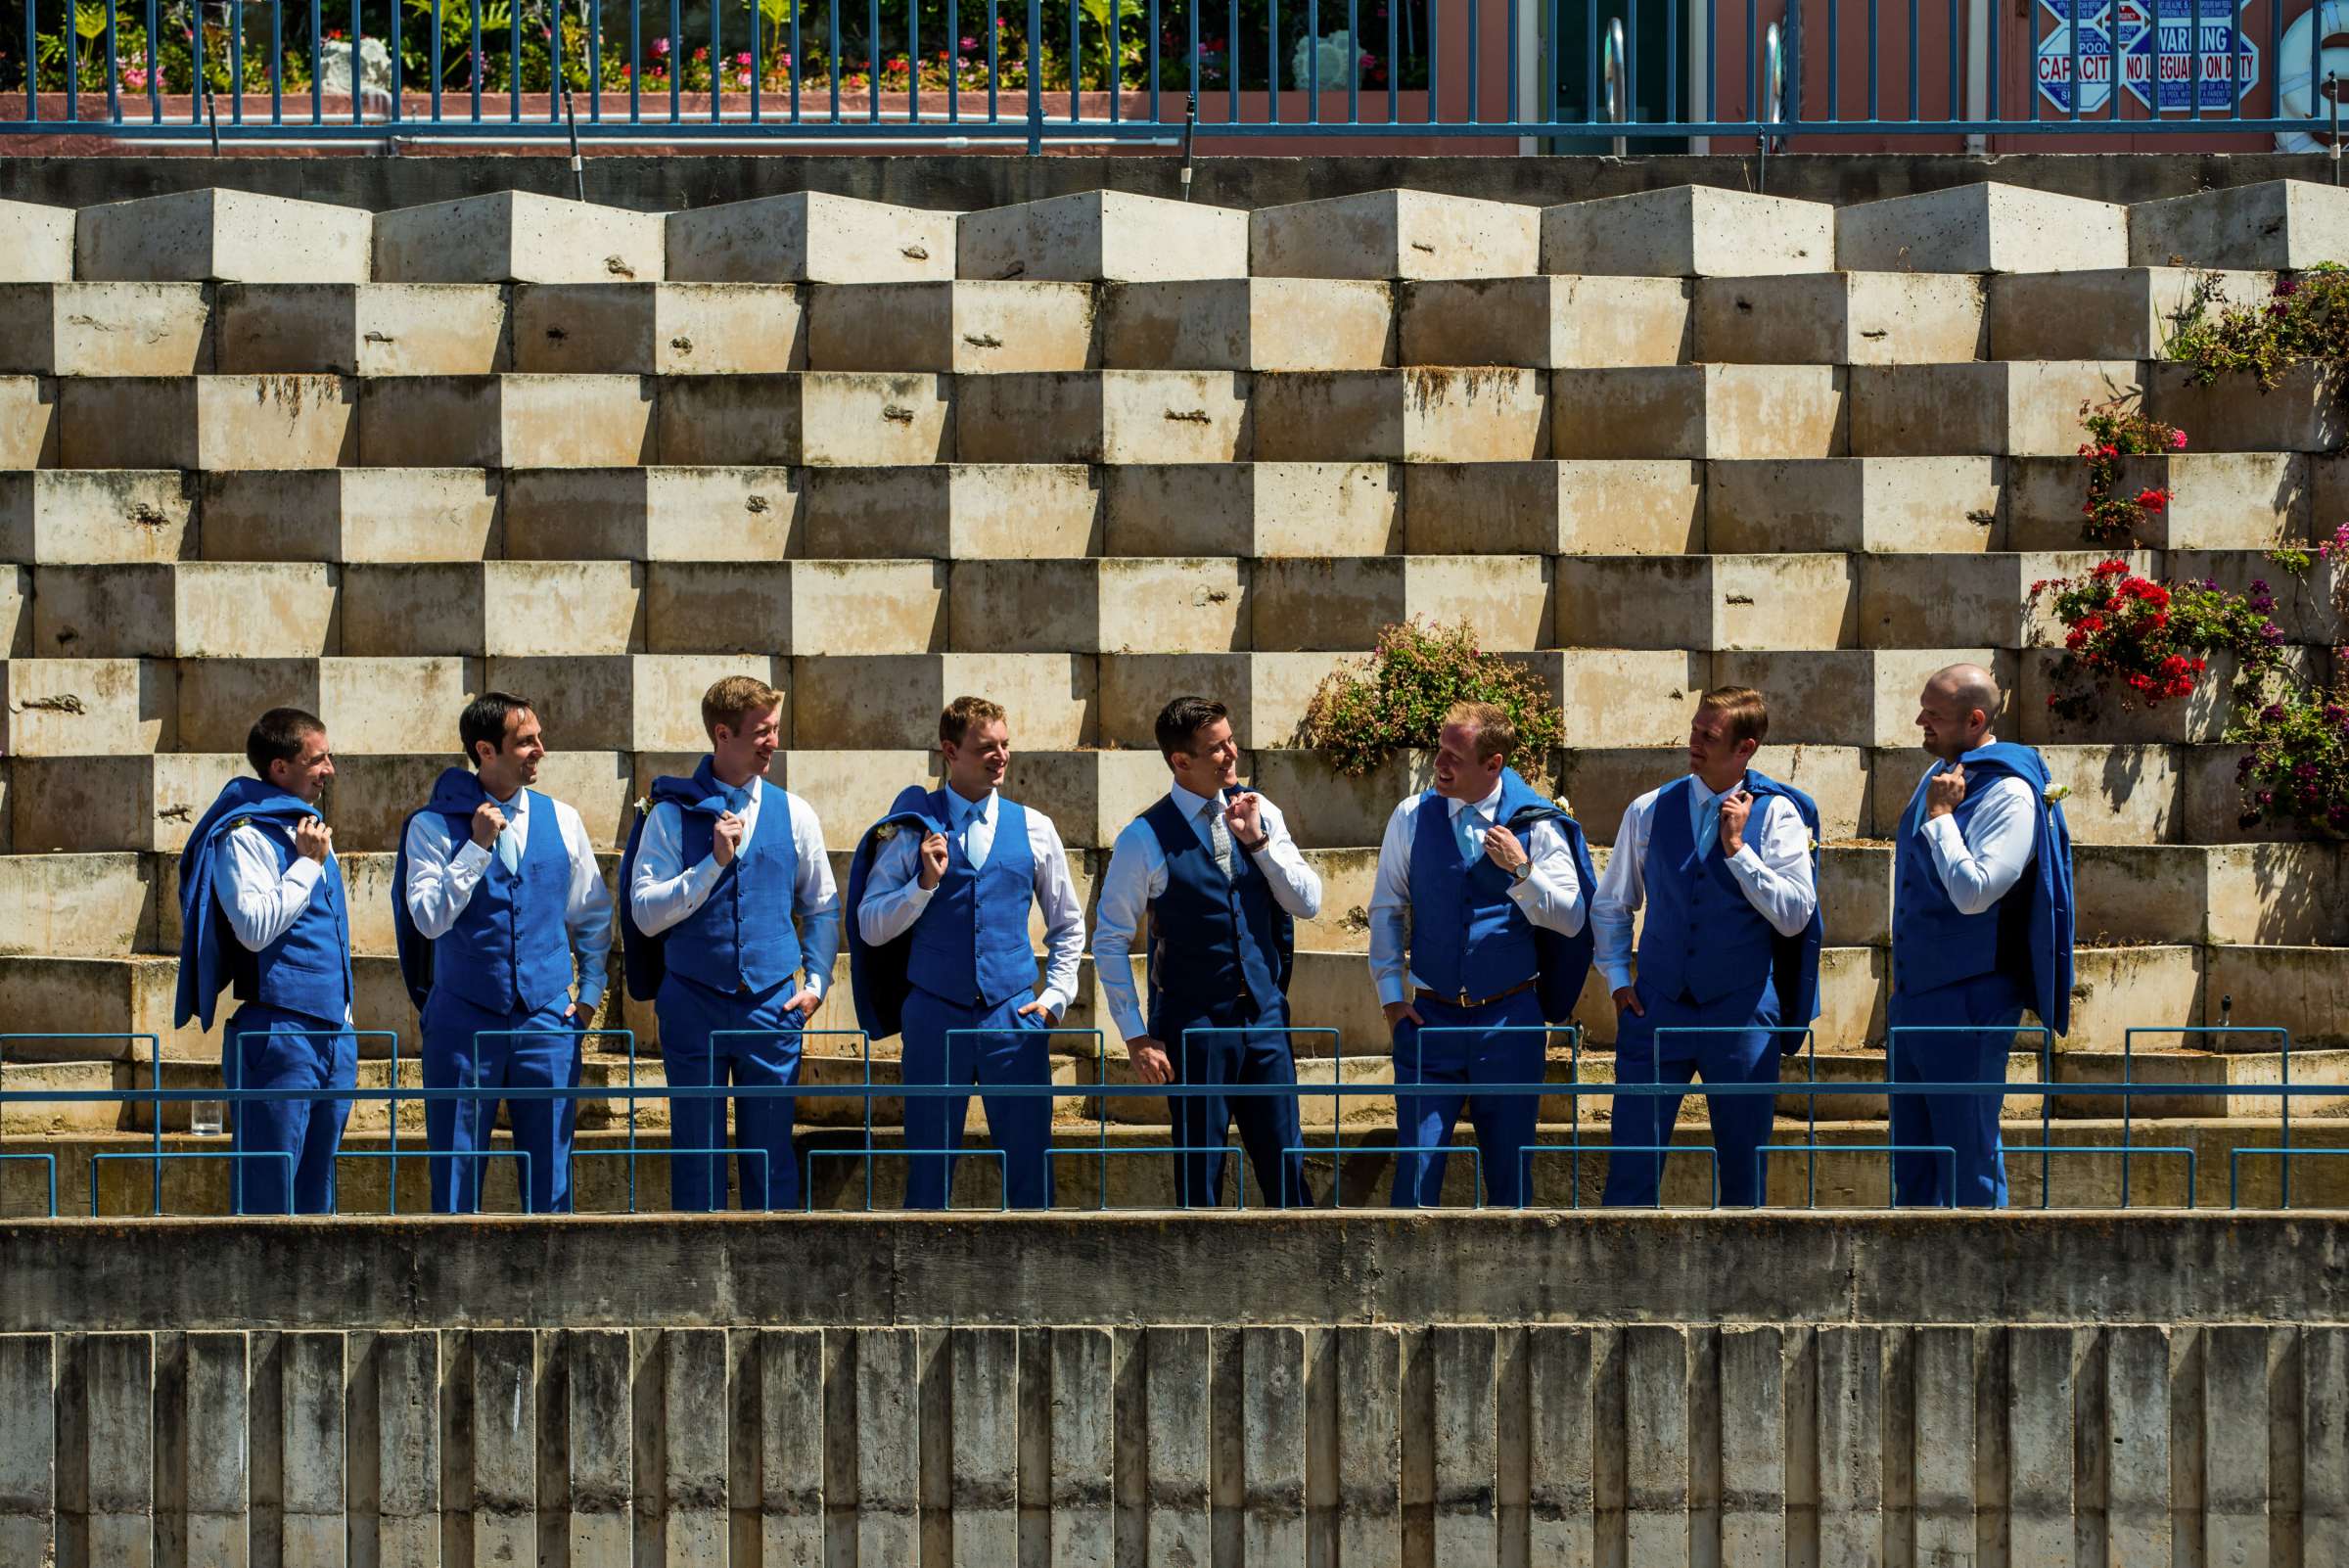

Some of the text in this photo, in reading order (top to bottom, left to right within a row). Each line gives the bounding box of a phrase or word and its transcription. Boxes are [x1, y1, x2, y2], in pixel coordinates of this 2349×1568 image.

[2079, 42, 2109, 54] POOL
[2126, 56, 2142, 79] NO
[2205, 56, 2222, 79] ON
[2225, 56, 2253, 79] DTY
